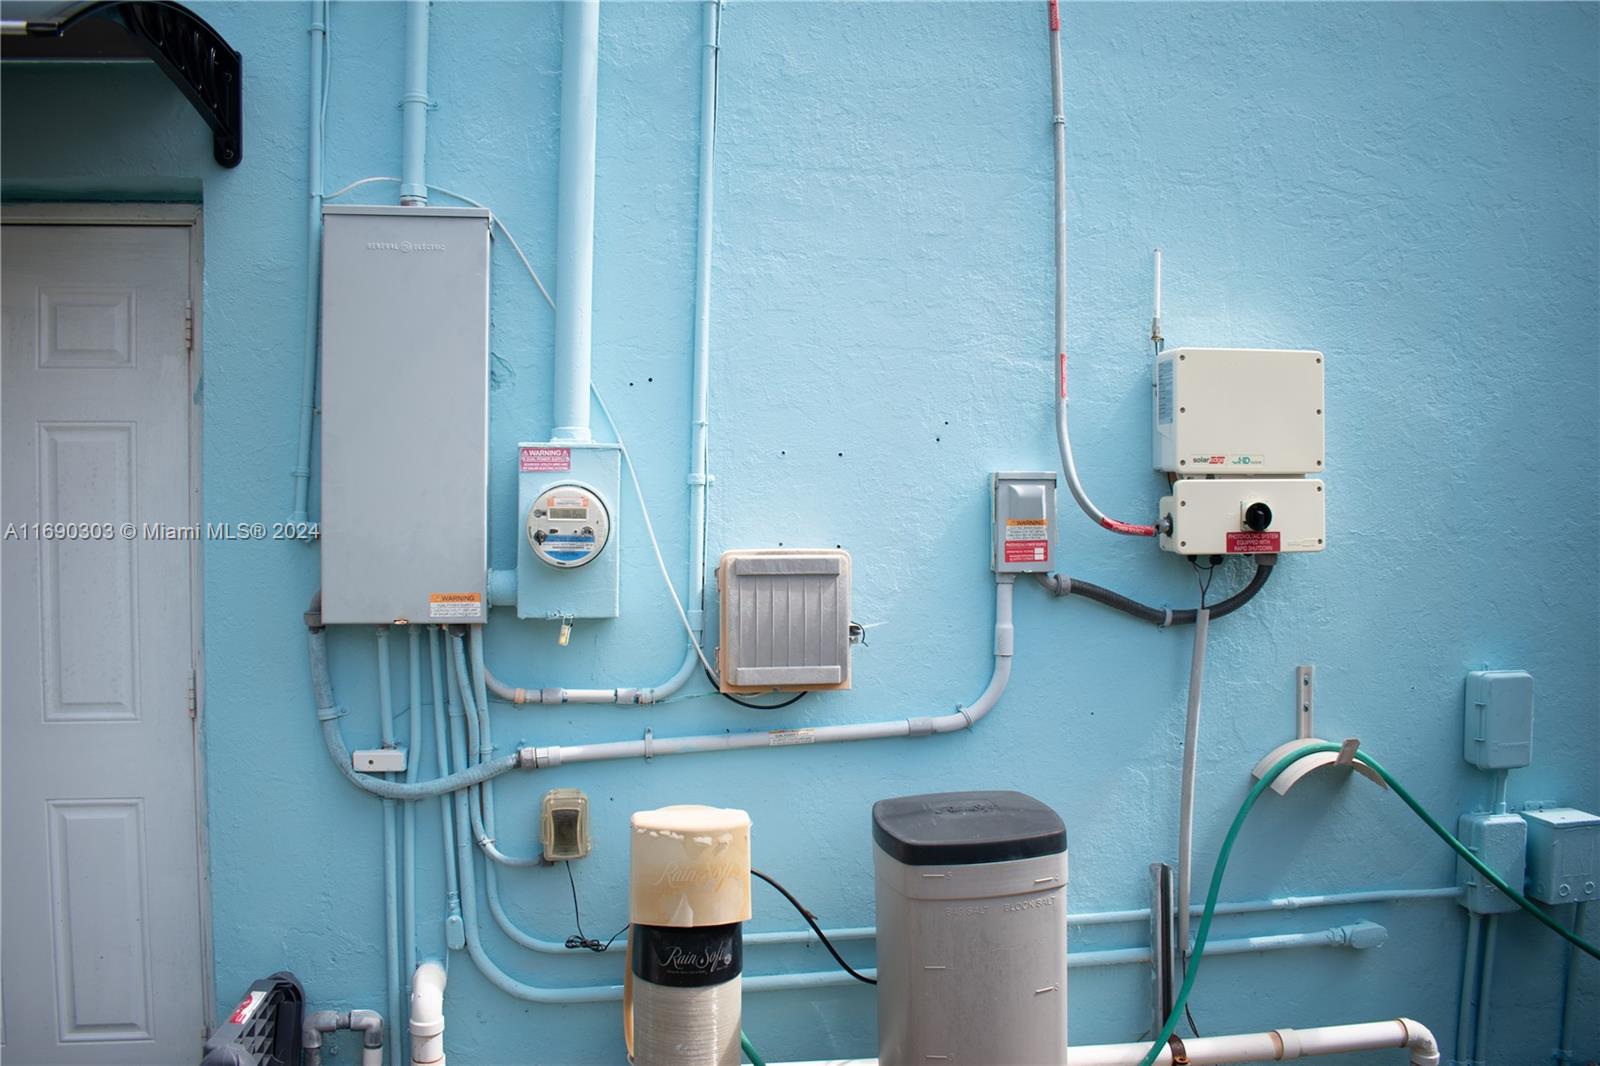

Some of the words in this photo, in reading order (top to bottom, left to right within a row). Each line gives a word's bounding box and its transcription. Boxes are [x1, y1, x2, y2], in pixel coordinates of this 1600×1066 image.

[441, 594, 475, 602] WARNING
[1003, 900, 1034, 912] BLOCK
[1033, 895, 1057, 908] SALT
